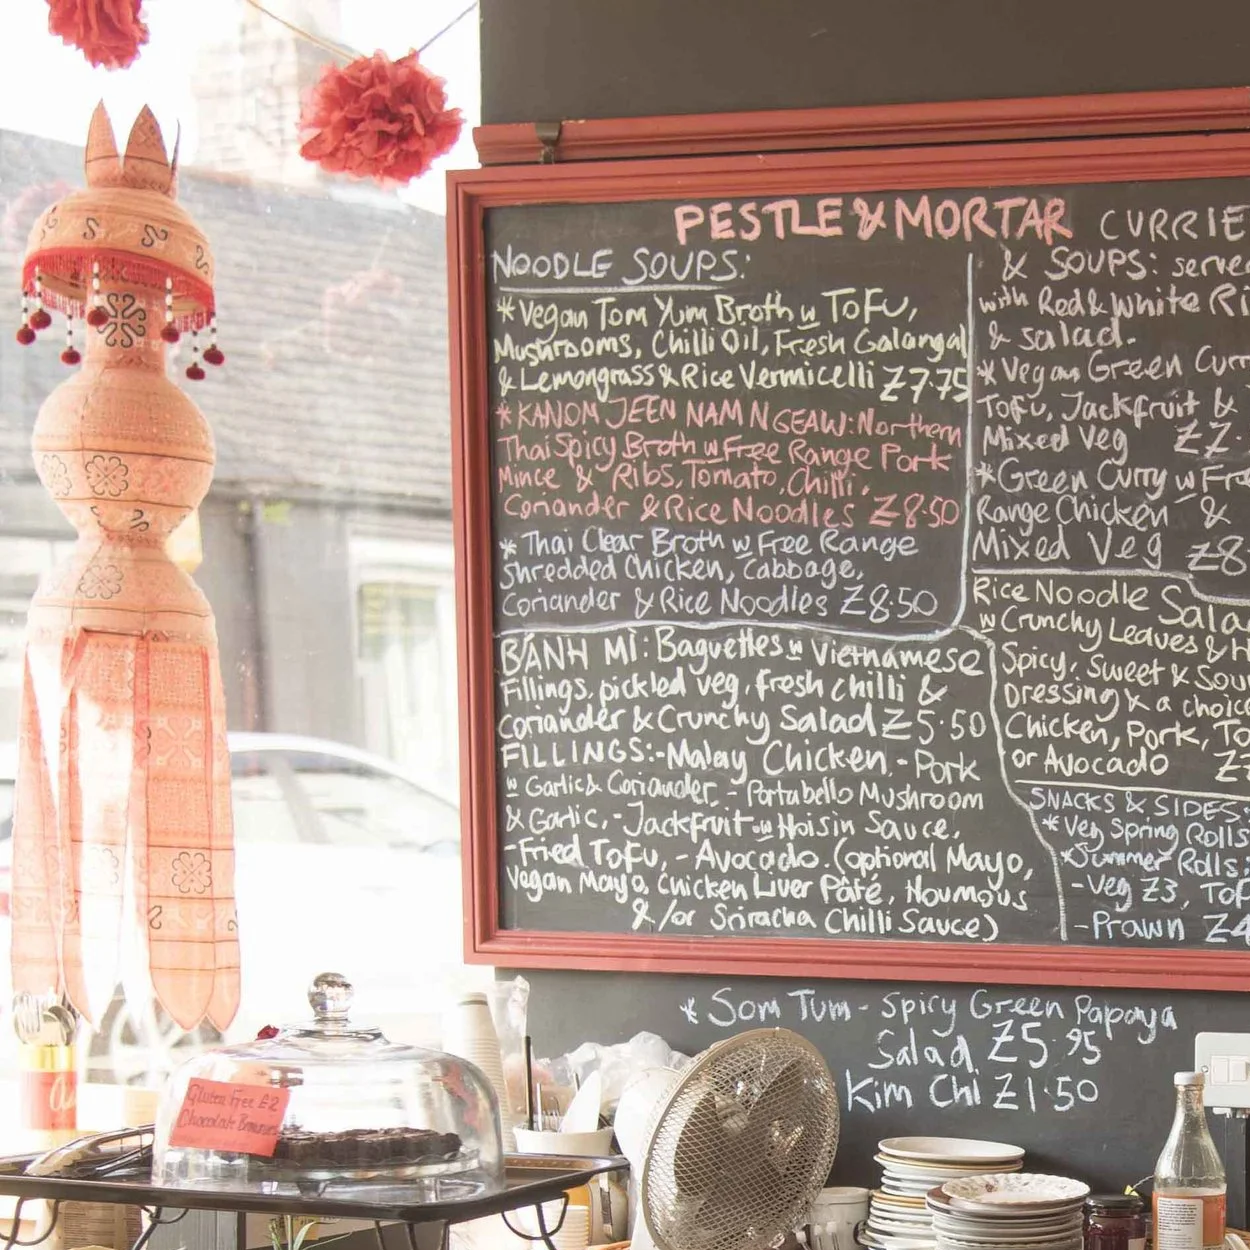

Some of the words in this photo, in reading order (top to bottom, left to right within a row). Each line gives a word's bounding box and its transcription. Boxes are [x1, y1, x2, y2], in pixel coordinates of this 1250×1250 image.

[673, 198, 844, 244] PESTLE
[895, 195, 1074, 244] MORTAR
[493, 248, 614, 282] NOODLE
[621, 246, 750, 285] SOUPS:
[1045, 245, 1158, 281] SOUPS:
[594, 297, 648, 330] Tom
[656, 294, 707, 325] Yum
[716, 291, 795, 325] Broth
[1038, 285, 1085, 317] Red
[652, 328, 715, 357] Chilli
[681, 363, 734, 391] Rice
[739, 361, 874, 391] Vermicelli
[1088, 350, 1184, 382] Green
[517, 401, 600, 429] KANOM
[606, 396, 677, 430] JEEN
[498, 436, 551, 465] Thai
[621, 432, 696, 459] Broth
[789, 439, 873, 472] Range
[882, 444, 955, 473] Pork
[982, 423, 1069, 456] Mixed
[1078, 423, 1129, 466] Veg
[498, 465, 555, 494] Mince
[998, 457, 1088, 494] Green
[1097, 458, 1167, 500] Curry
[664, 498, 728, 526] Rice
[733, 496, 856, 530] Noodles
[976, 494, 1051, 537] Range
[1056, 493, 1169, 532] Chicken
[521, 530, 575, 557] Thai
[582, 525, 643, 555] Clear
[651, 527, 726, 558] Broth
[757, 532, 814, 558] Free
[819, 533, 919, 561] Range
[972, 523, 1071, 561] Mixed
[1088, 526, 1163, 571] Veg
[660, 590, 712, 615] Rice
[719, 588, 828, 617] Noodles
[972, 576, 1031, 605] Rice
[1035, 578, 1151, 611] Noodle
[1001, 605, 1104, 653] Crunchy
[1108, 617, 1199, 653] Leaves
[657, 624, 784, 675] Baguettes
[813, 641, 985, 678] Vietnamese
[1087, 653, 1167, 687] Sweet
[1004, 681, 1120, 722] Dressing
[659, 705, 770, 744] Crunchy
[780, 703, 875, 737] Salad
[1044, 743, 1170, 778] Avocado
[865, 781, 985, 812] Mushroom
[1028, 786, 1116, 813] SNACKS
[1111, 817, 1180, 851] Spring
[753, 869, 810, 900] Liver
[1093, 911, 1187, 941] Prawn
[707, 986, 781, 1029] Som
[880, 990, 959, 1037] Spicy
[970, 988, 1066, 1022] Green
[1073, 994, 1179, 1046] Papaya
[868, 1031, 978, 1071] Salad
[845, 1068, 915, 1114] Kim
